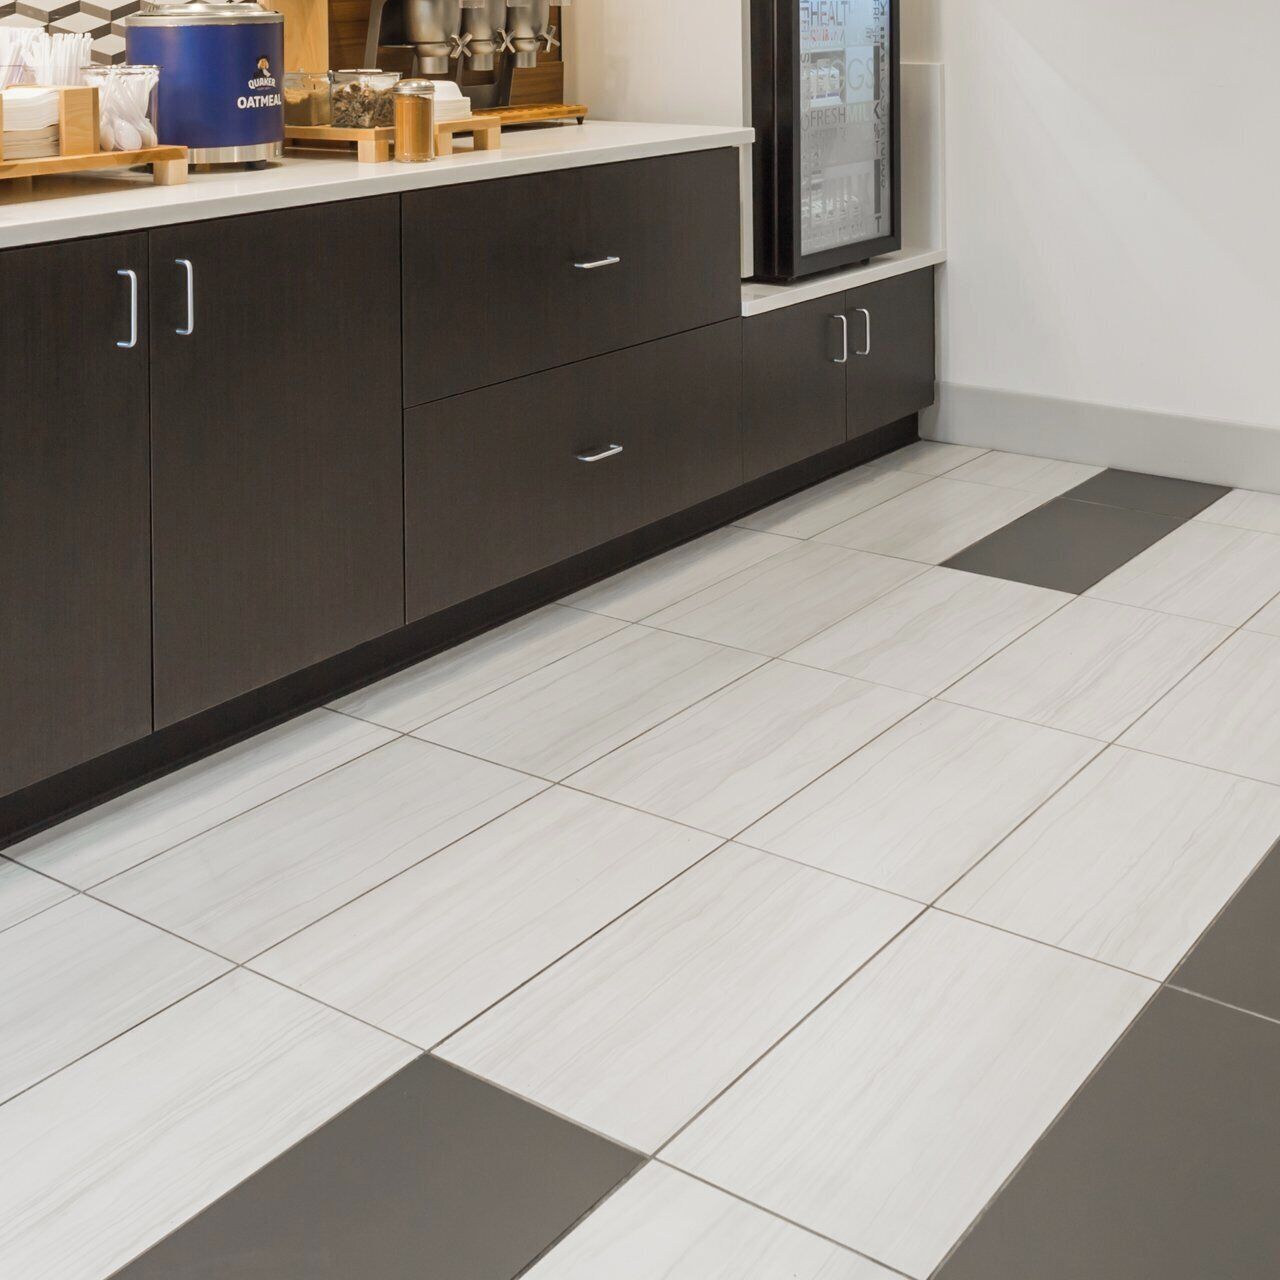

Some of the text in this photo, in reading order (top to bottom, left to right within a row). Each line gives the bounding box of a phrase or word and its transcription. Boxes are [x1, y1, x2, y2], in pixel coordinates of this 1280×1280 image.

[248, 77, 276, 90] QUAKER
[237, 93, 282, 109] OATMEAL
[810, 106, 846, 128] FRESH
